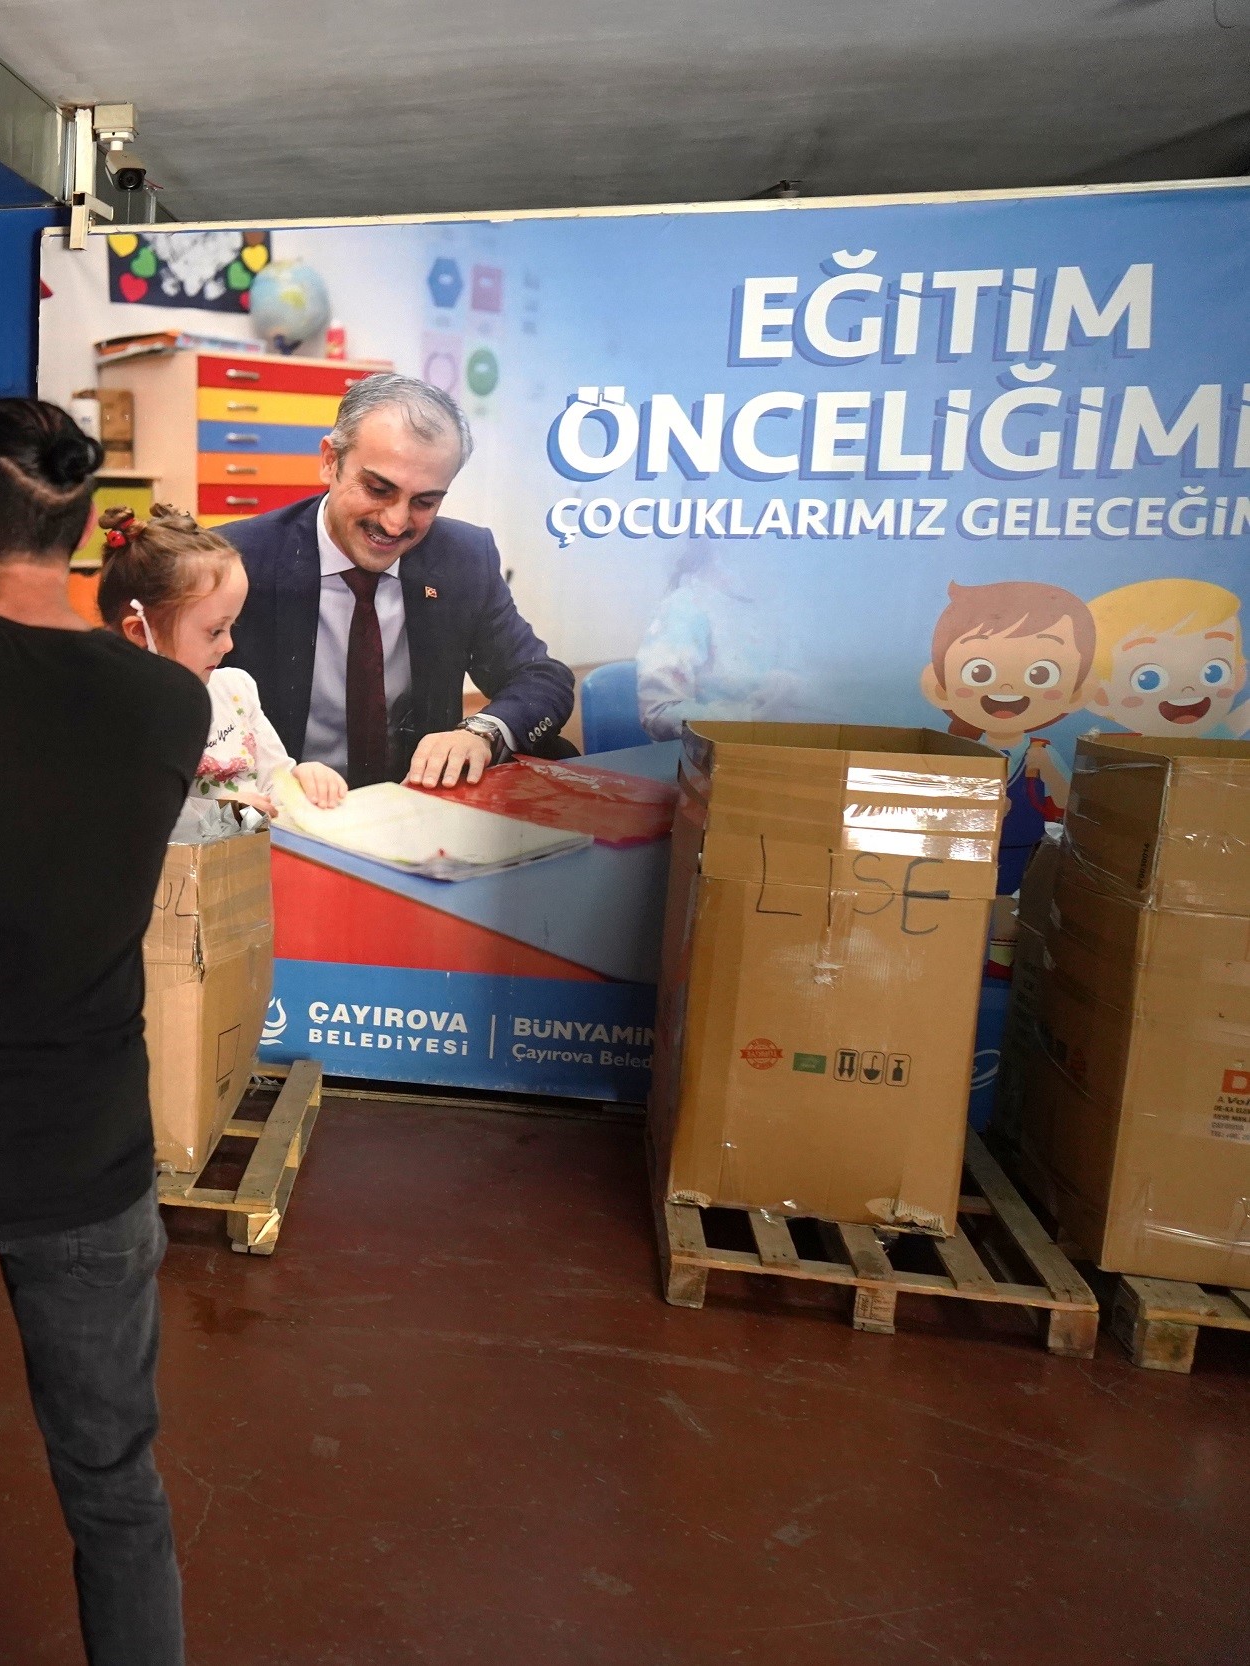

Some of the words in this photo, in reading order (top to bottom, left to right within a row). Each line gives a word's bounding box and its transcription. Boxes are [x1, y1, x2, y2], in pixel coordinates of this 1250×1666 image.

[739, 248, 1153, 358] EĞİTİM
[550, 498, 948, 543] ÇOCUKLARIMIZ
[308, 1001, 468, 1034] ÇAYIROVA
[308, 1028, 468, 1056] BELEDİYESİ
[511, 1043, 594, 1064] Çayırova
